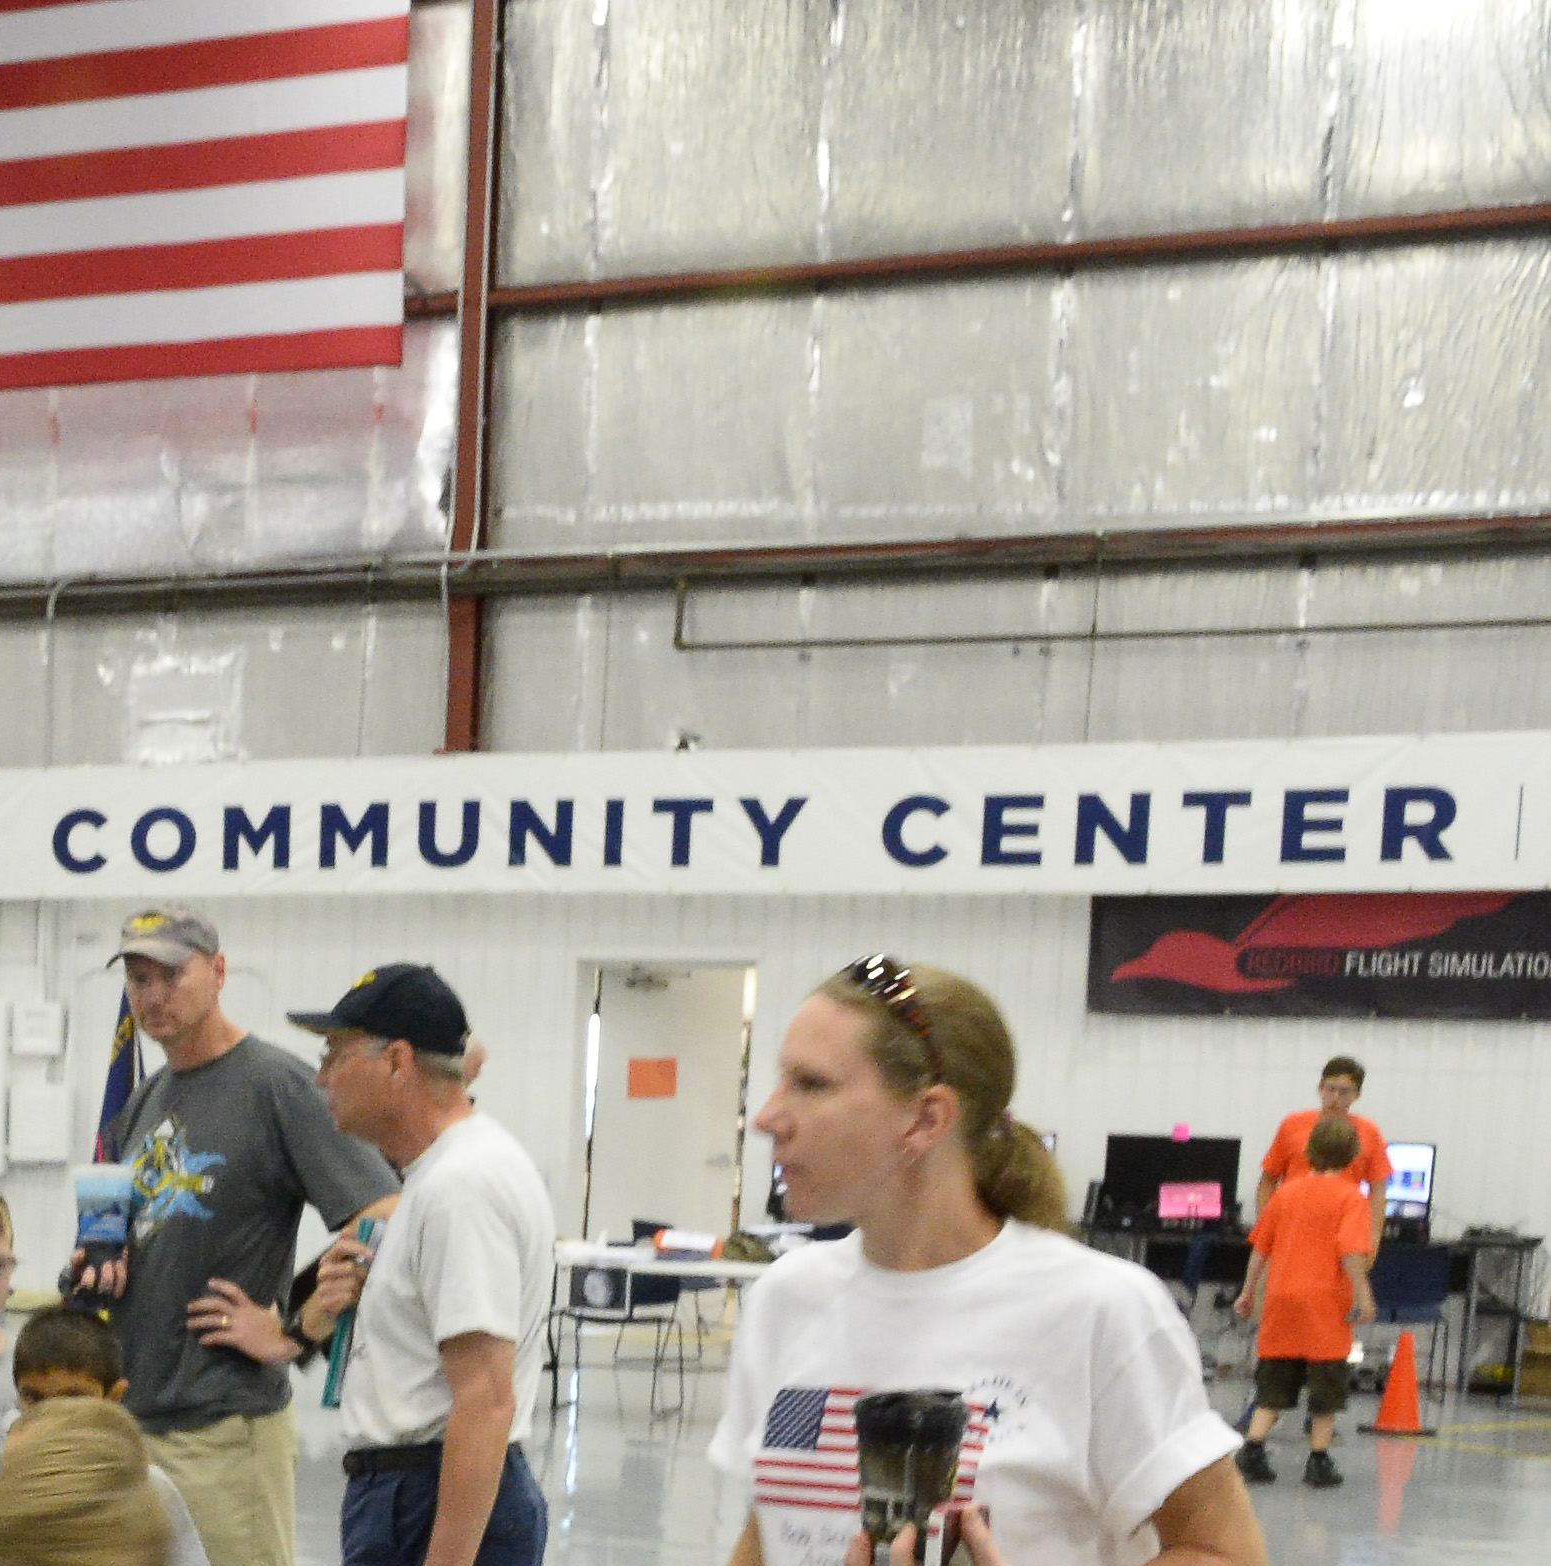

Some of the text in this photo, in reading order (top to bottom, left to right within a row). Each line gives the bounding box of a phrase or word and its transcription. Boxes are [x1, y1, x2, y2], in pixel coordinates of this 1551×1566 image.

[52, 797, 809, 874] COMMUNITY
[881, 785, 1458, 868] CENTER
[1344, 949, 1423, 977] FLIGHT
